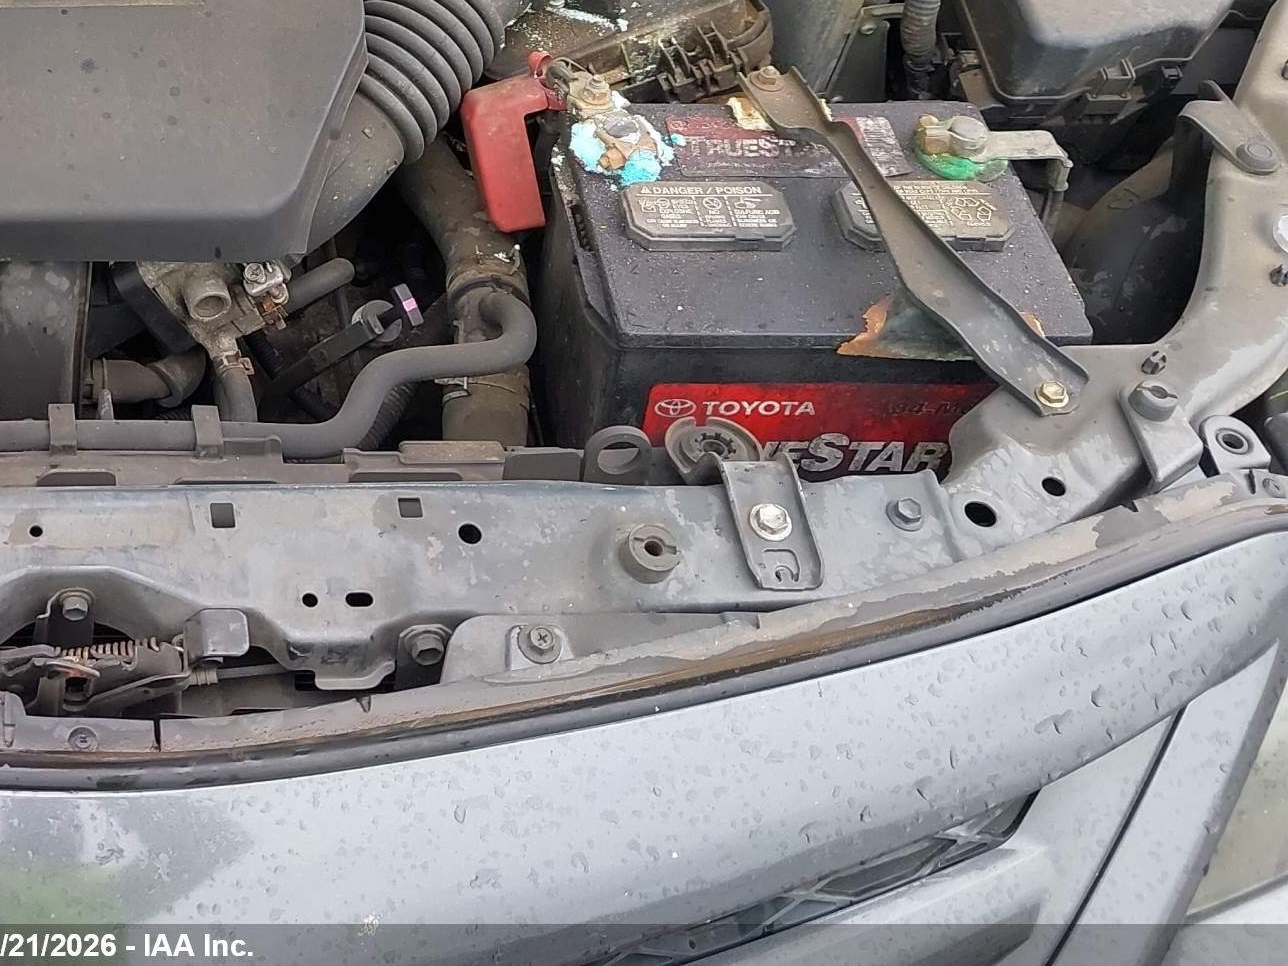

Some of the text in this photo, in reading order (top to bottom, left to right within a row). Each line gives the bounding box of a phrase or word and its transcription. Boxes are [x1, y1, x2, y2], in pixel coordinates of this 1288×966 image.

[652, 186, 762, 195] DANGER / POISON
[703, 401, 815, 416] TOYOTA
